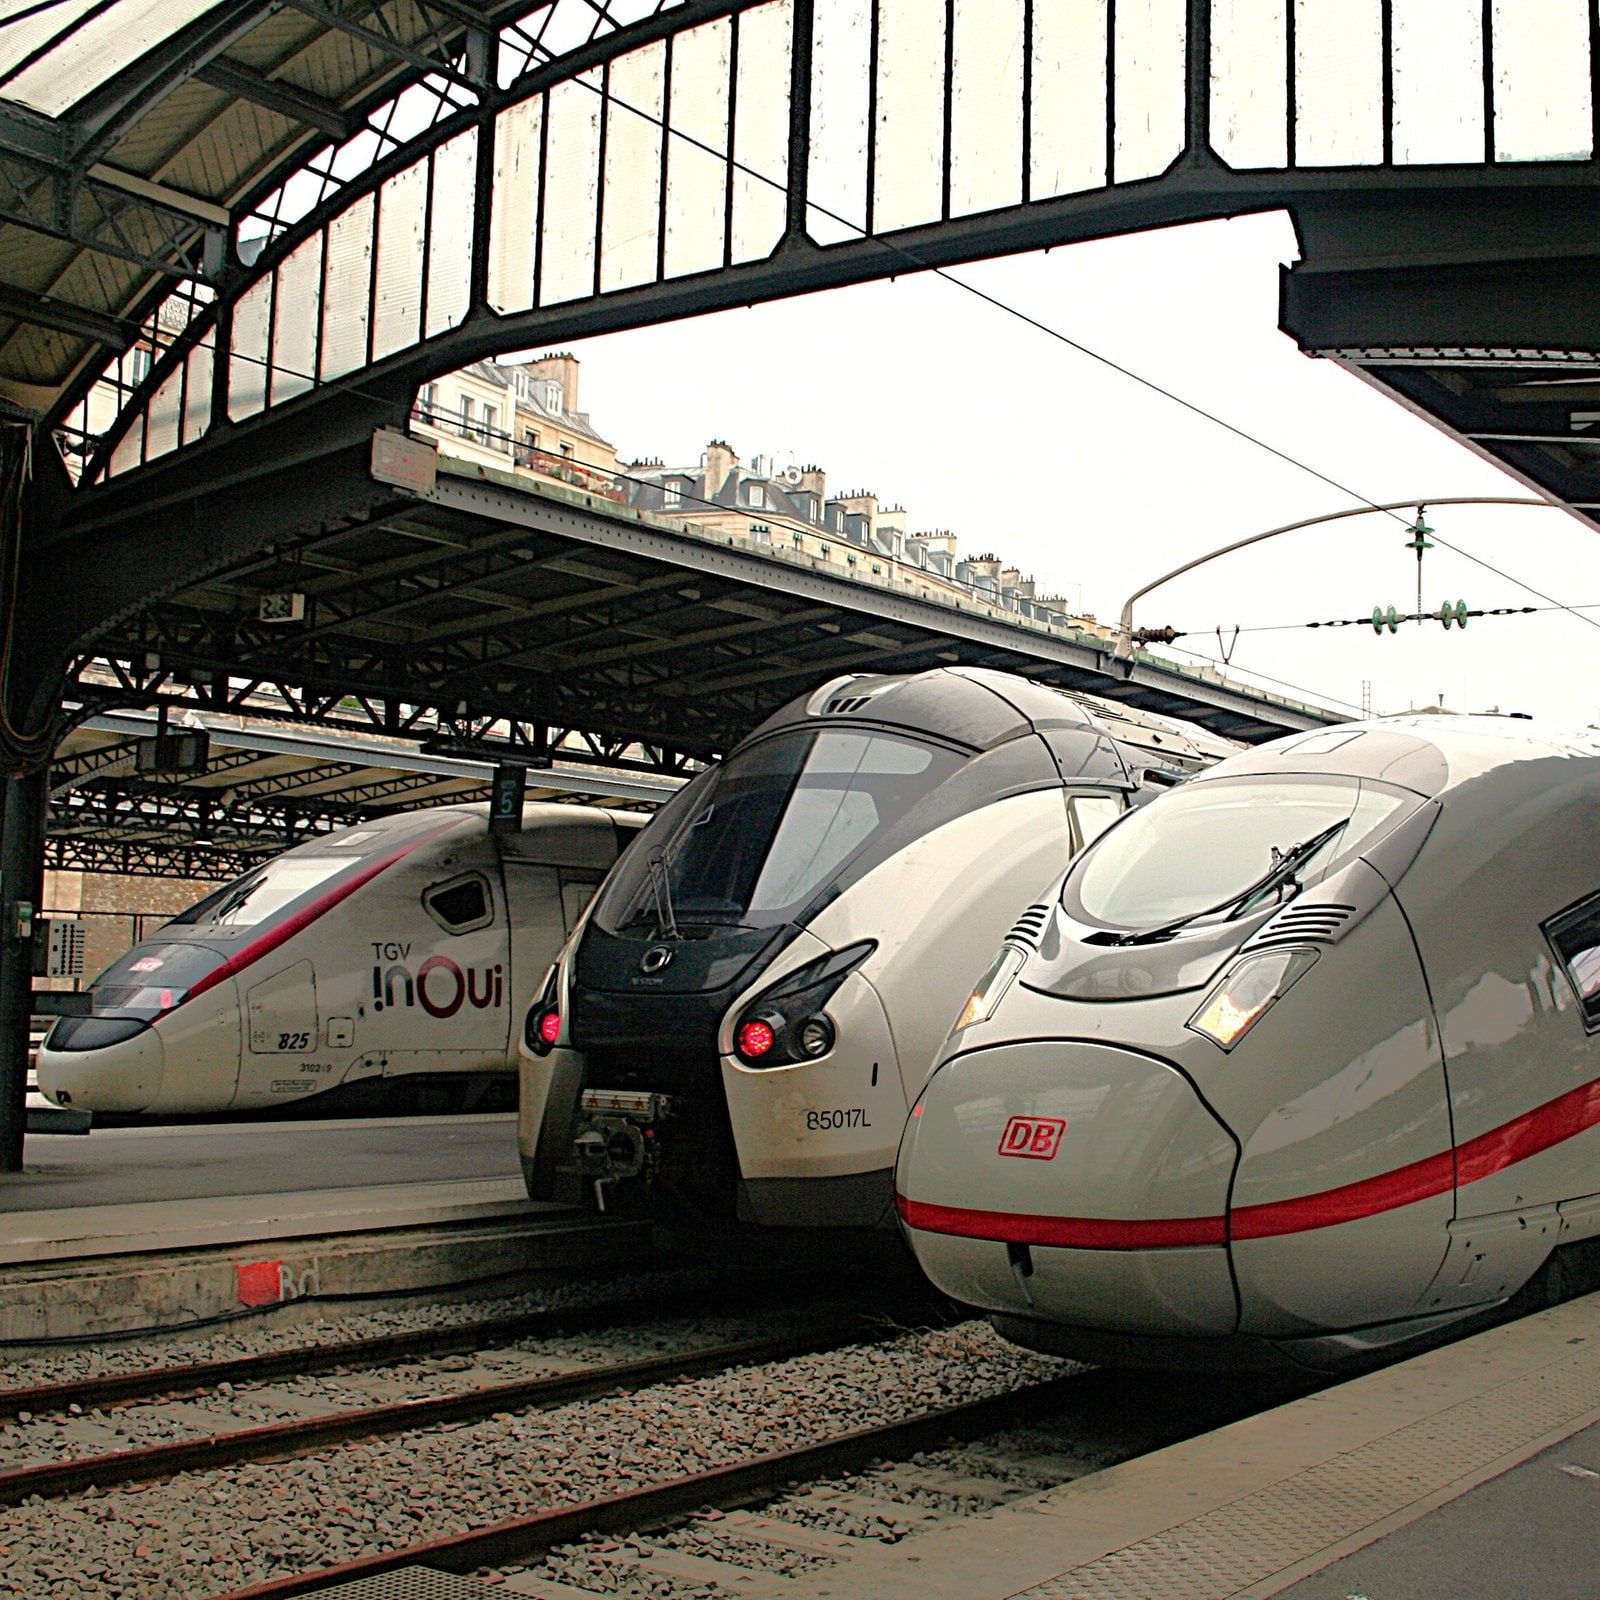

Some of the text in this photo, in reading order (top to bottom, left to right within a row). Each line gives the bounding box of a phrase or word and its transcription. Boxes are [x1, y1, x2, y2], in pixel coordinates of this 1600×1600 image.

[501, 791, 513, 814] 5
[371, 943, 411, 961] TGV
[278, 1032, 310, 1050] 825
[299, 1063, 332, 1073] 31029
[806, 1108, 872, 1131] 85017L
[1007, 1122, 1055, 1153] DB
